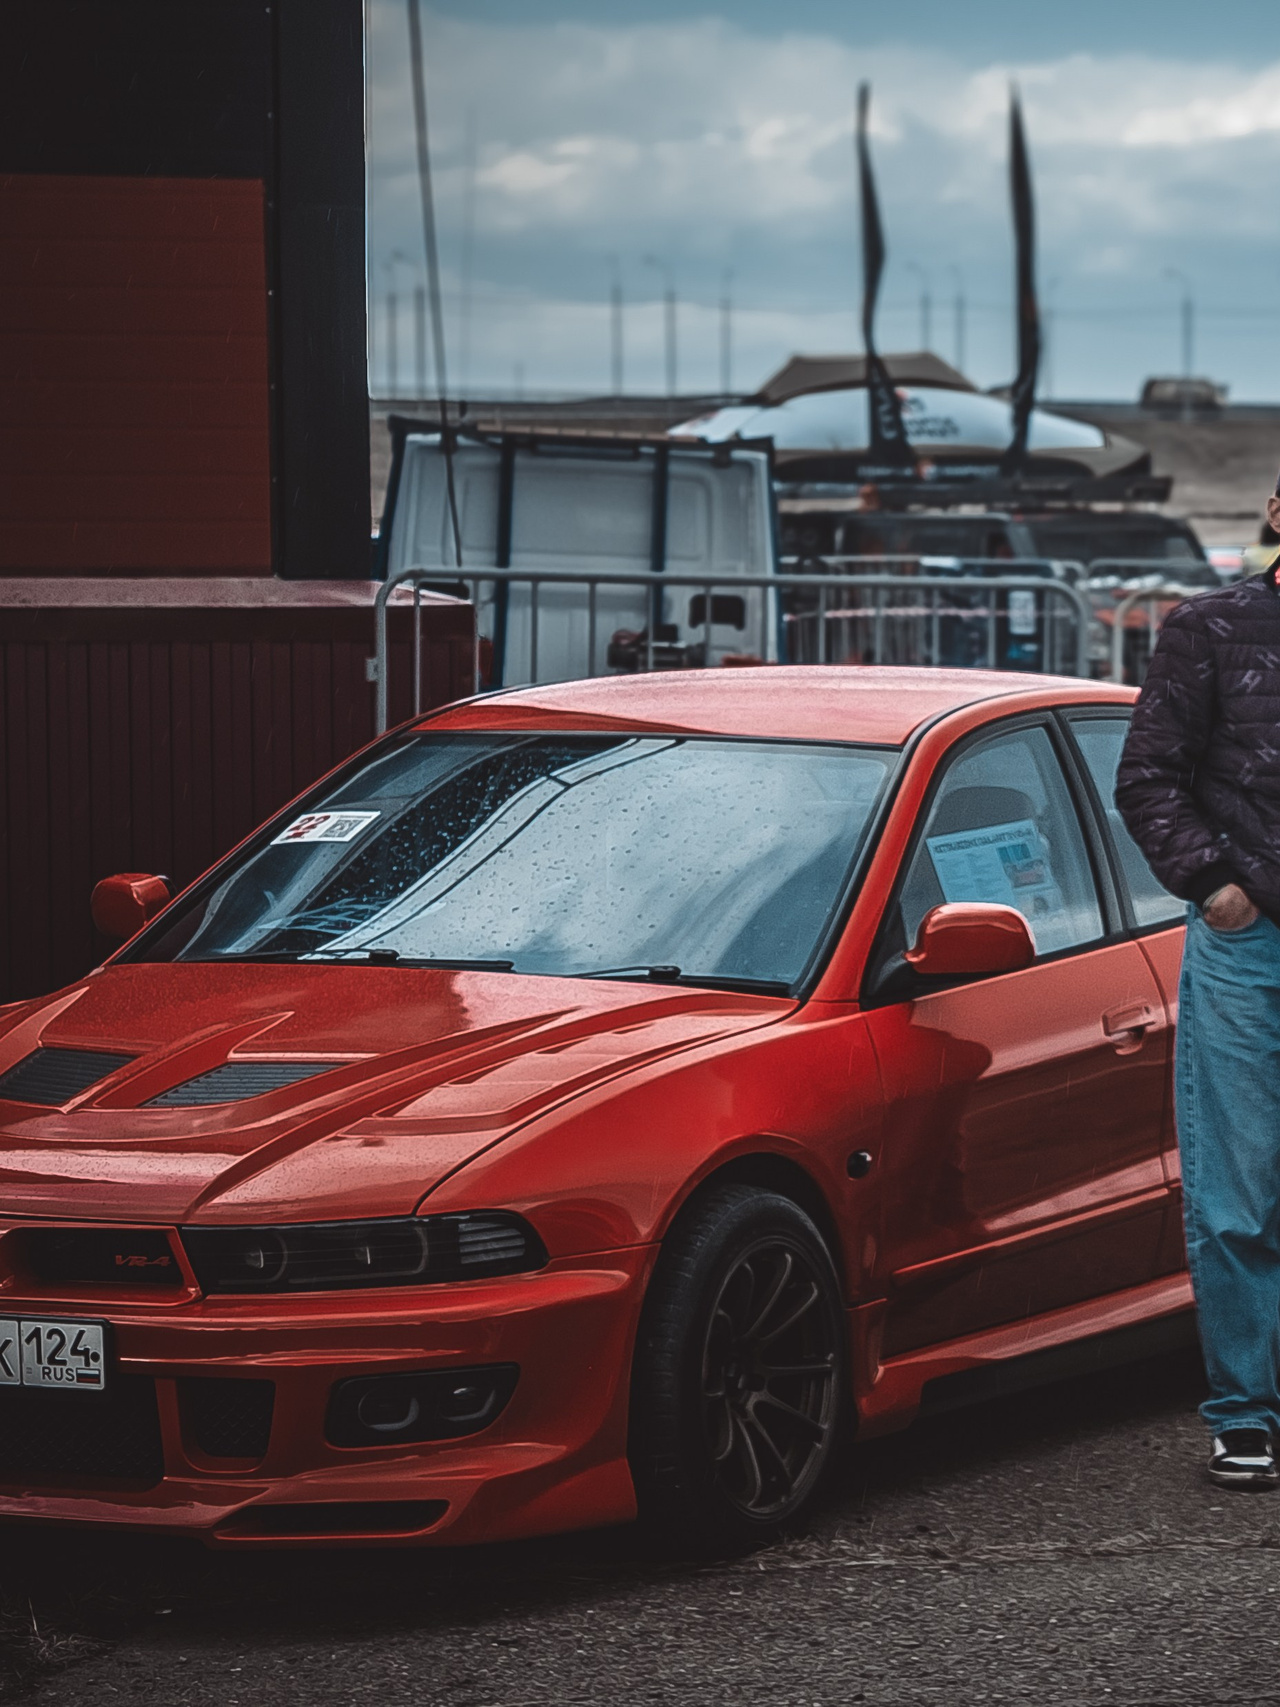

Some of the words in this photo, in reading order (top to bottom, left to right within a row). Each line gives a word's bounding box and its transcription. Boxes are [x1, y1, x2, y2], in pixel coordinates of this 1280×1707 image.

[287, 815, 331, 832] 22
[24, 1326, 91, 1368] 124
[42, 1366, 75, 1382] RUS
